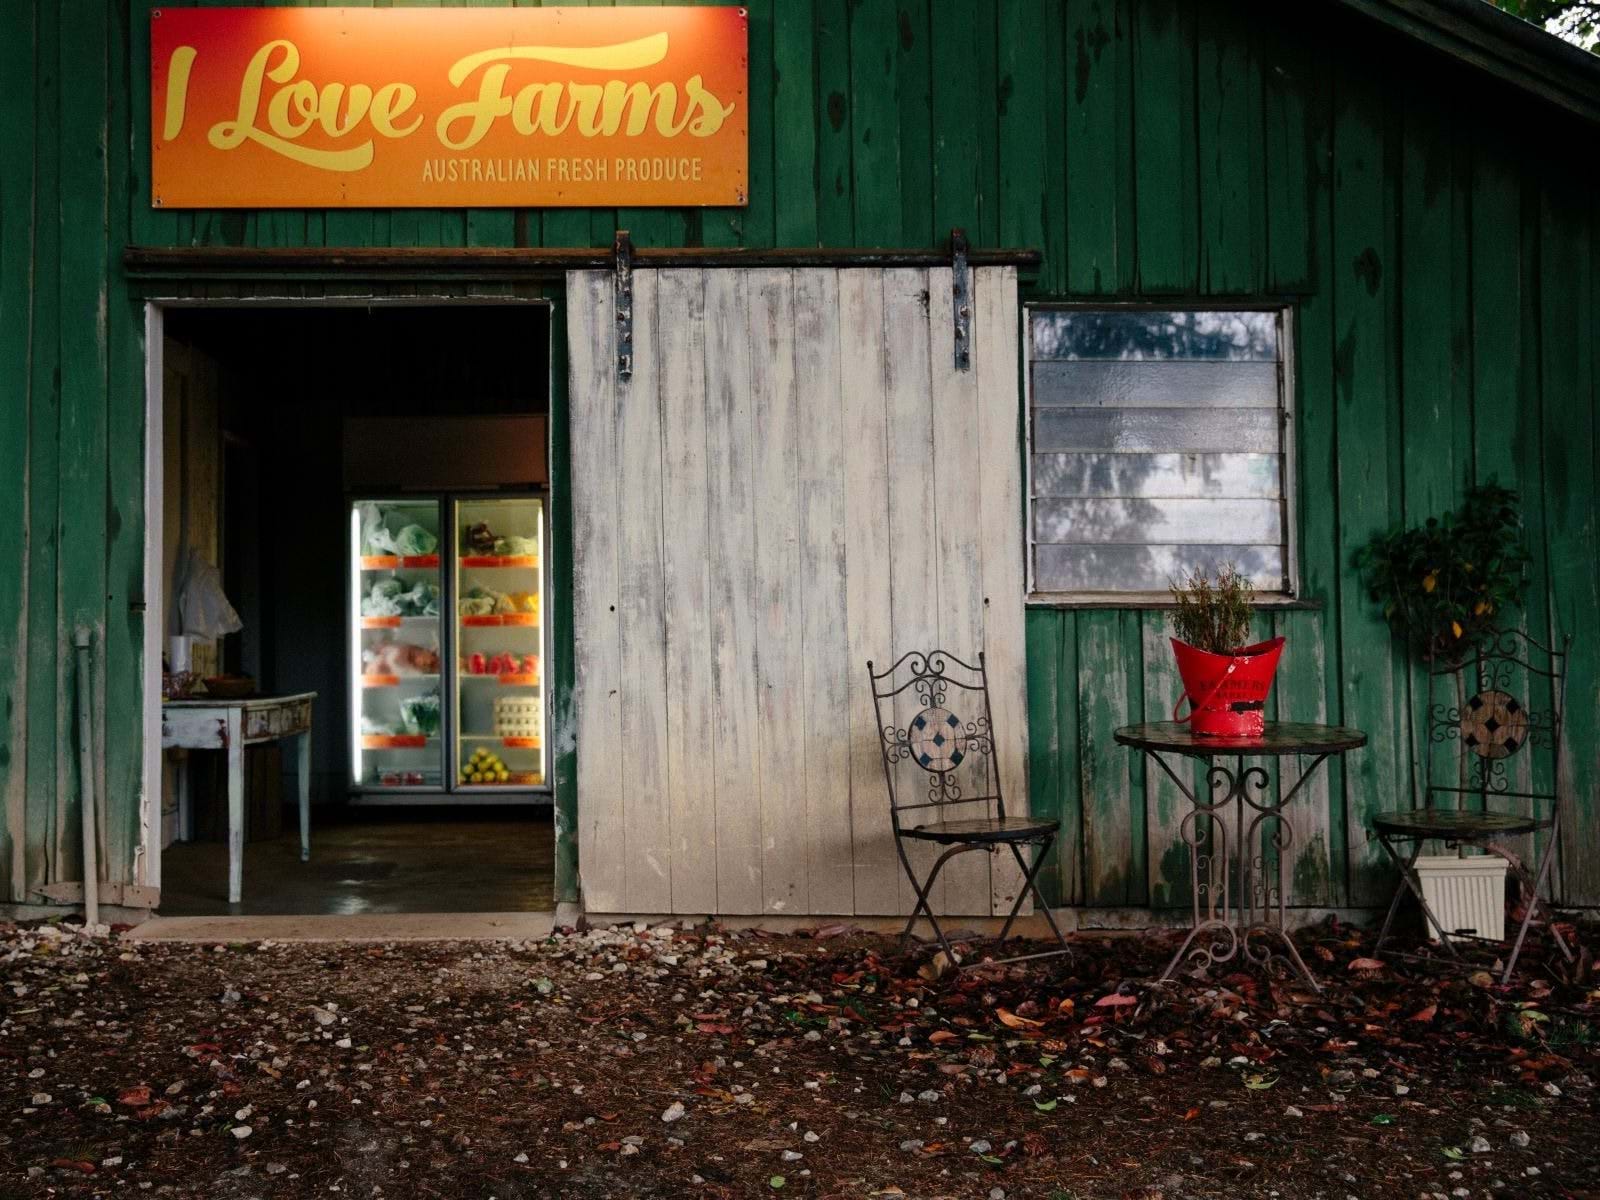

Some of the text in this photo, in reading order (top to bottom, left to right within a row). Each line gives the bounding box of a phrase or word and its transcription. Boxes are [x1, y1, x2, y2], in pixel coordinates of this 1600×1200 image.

[164, 31, 735, 172] I Love Farms
[422, 157, 702, 182] AUSTRALIAN FRESH PRODUCE
